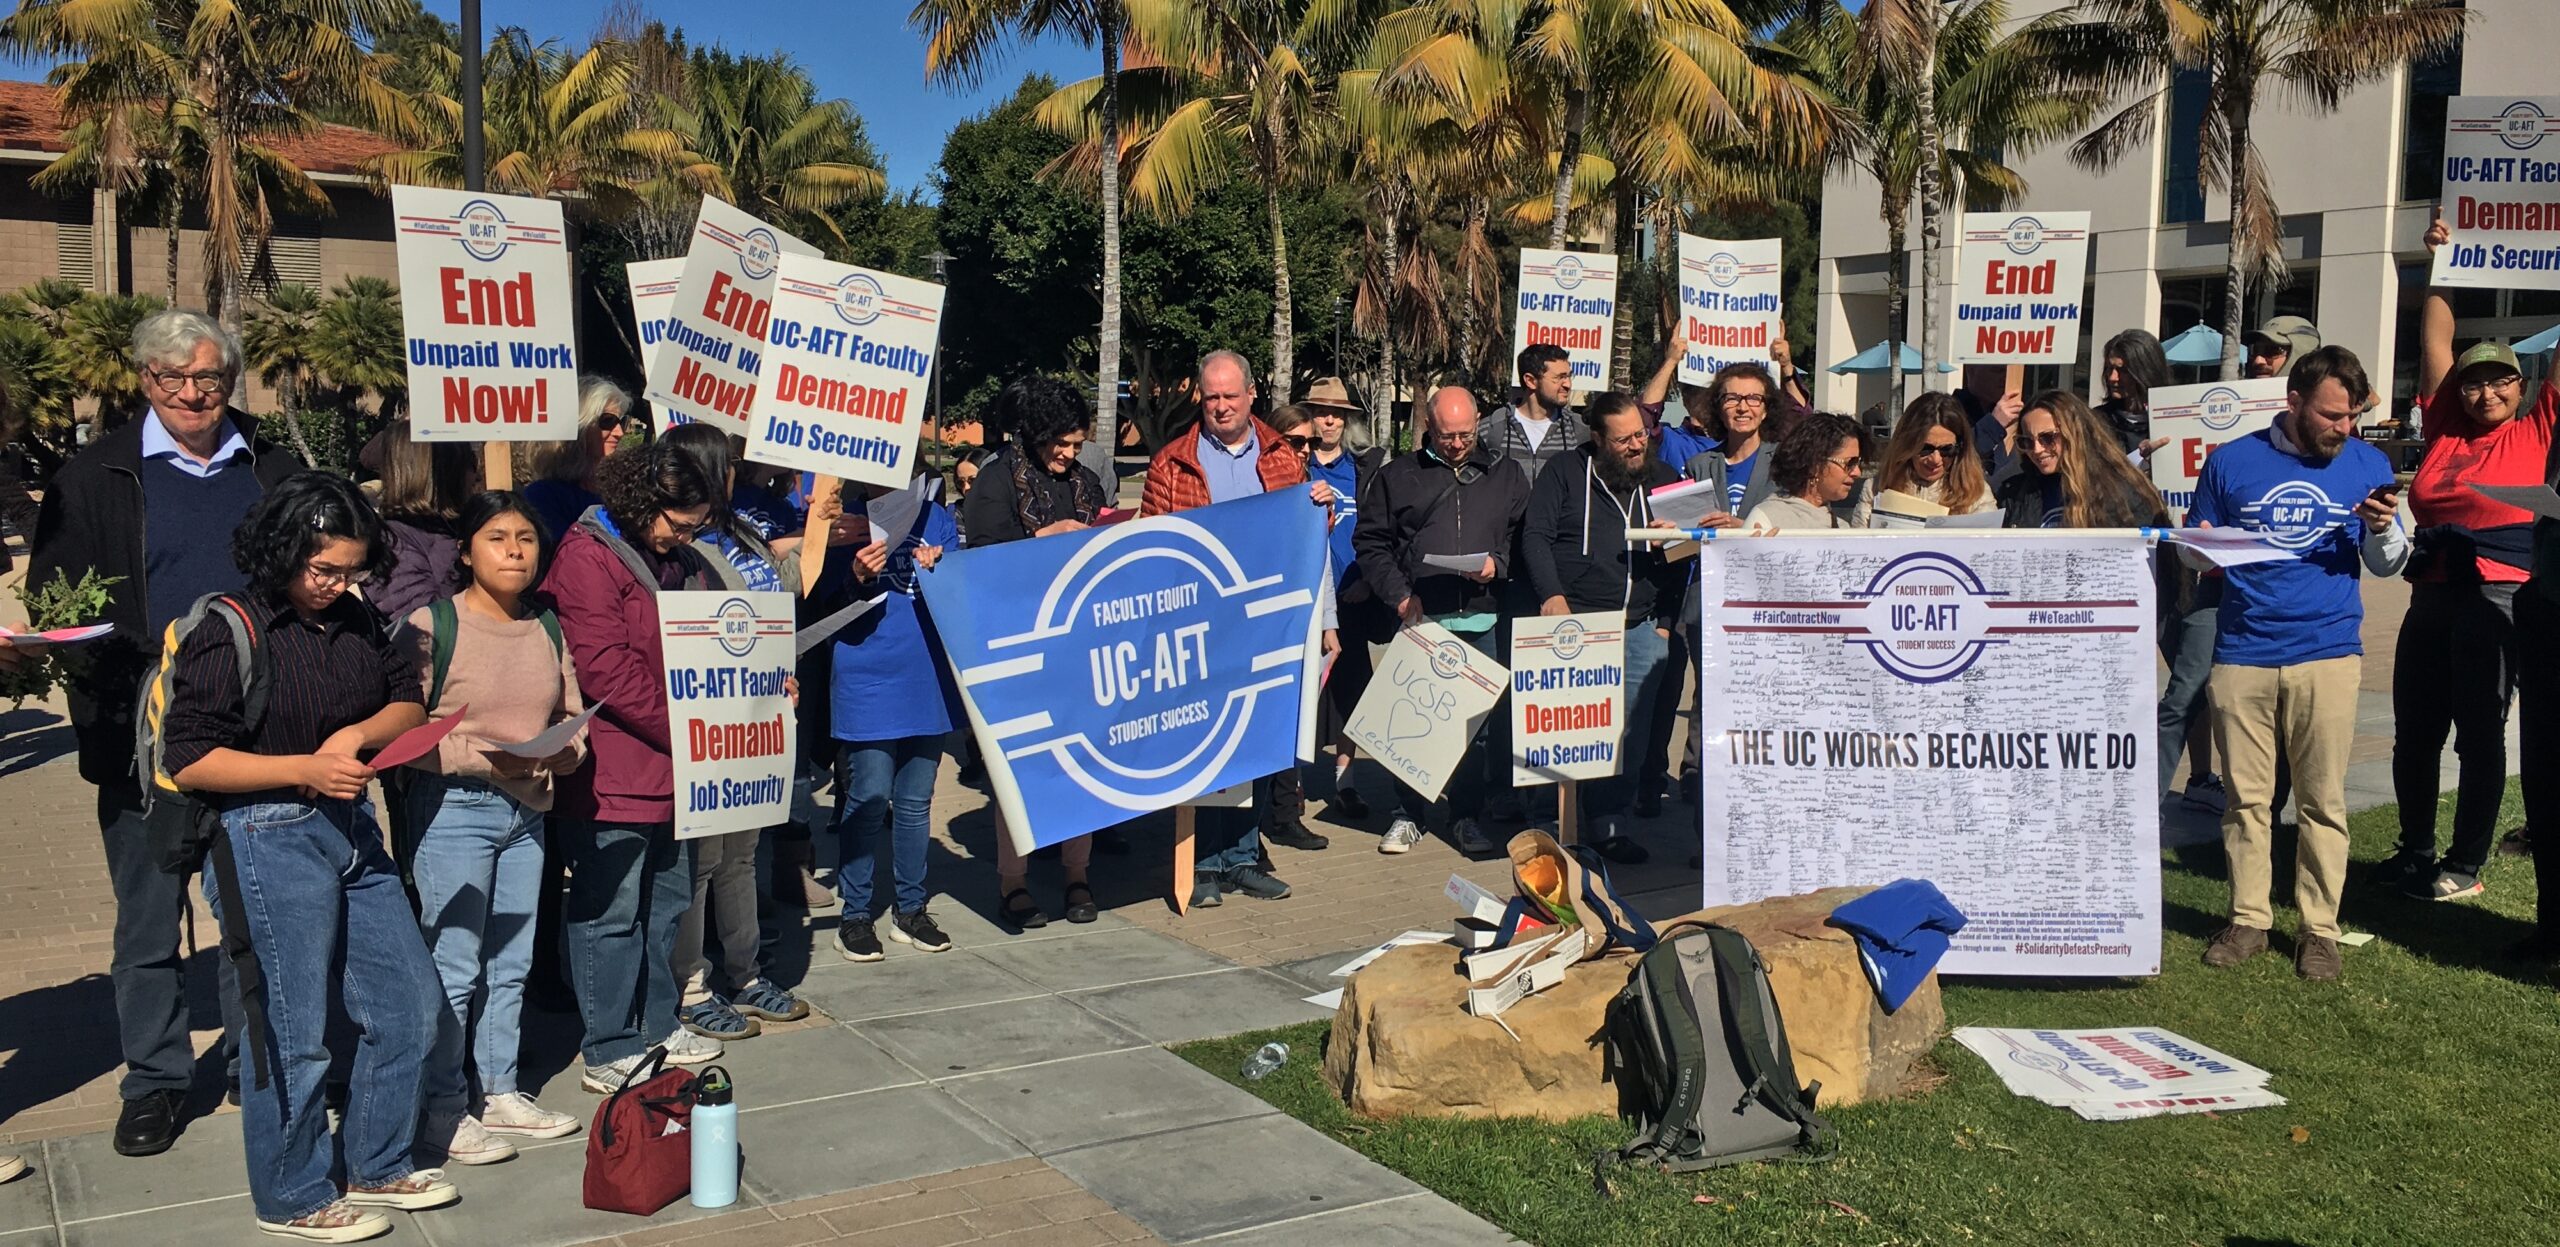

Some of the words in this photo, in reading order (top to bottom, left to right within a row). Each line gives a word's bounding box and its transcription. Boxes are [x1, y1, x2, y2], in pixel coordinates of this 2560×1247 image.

[2509, 121, 2534, 131] UC-AFT
[2447, 157, 2515, 183] UC-AFT
[2458, 196, 2560, 230] Deman
[469, 223, 497, 238] UC-AFT
[2014, 231, 2035, 240] UC-AFT
[748, 244, 770, 264] UC-AFT
[2450, 244, 2486, 268] Job
[2491, 245, 2560, 270] Securi
[1985, 260, 2057, 295] End
[440, 266, 536, 327] End
[703, 270, 773, 342] End
[845, 291, 873, 308] UC-AFT
[1521, 292, 1564, 312] UC-AFT
[1567, 295, 1613, 317] Faculty
[1682, 285, 1720, 311] UC-AFT
[1723, 293, 1778, 312] Faculty
[1958, 304, 2022, 322] Unpaid
[2030, 303, 2079, 320] Work
[667, 316, 733, 363] Unpaid
[1527, 321, 1602, 349] Demand
[1689, 315, 1767, 347] Demand
[1976, 326, 2055, 354] Now!
[409, 338, 500, 369] Unpaid
[509, 341, 573, 369] Work
[770, 318, 848, 358] UC-AFT
[849, 334, 930, 378] Faculty
[1686, 351, 1704, 373] Job
[443, 376, 548, 424] Now!
[672, 355, 757, 422] Now!
[776, 363, 908, 424] Demand
[2208, 404, 2232, 414] UC-AFT
[765, 416, 804, 448] Job
[808, 424, 901, 469] Security
[2273, 507, 2315, 523] UC-AFT
[1093, 593, 1153, 627] FACULTY
[1156, 581, 1199, 614] EQUITY
[1896, 585, 1926, 597] FACULTY
[1928, 585, 1955, 597] EQUITY
[726, 621, 748, 633] UC-AFT
[1752, 610, 1841, 625] #FairContractNow
[1891, 604, 1960, 631] UC-AFT
[2028, 611, 2095, 625] #WeTeachUC
[1559, 634, 1578, 645] UC-AFT
[1896, 640, 1925, 650] STUDENT
[1927, 640, 1956, 650] SUCCESS
[1090, 621, 1210, 706] UC-AFT
[670, 668, 736, 700] UC-AFT
[740, 666, 793, 698] Faculty
[1393, 660, 1456, 721] UCSB
[1514, 667, 1565, 692] UC-AFT
[1569, 664, 1621, 688] Faculty
[1109, 714, 1159, 746] STUDENT
[1161, 700, 1209, 731] SUCCESS
[1525, 698, 1612, 734] Demand
[688, 713, 785, 762] Demand
[1354, 716, 1431, 786] Lecturers
[1726, 729, 1775, 766] THE
[1783, 730, 1816, 767] UC
[1824, 731, 1919, 768] WORKS
[1927, 733, 2049, 769] BECAUSE
[2057, 733, 2098, 769] WE
[2106, 733, 2136, 769] DO
[1525, 746, 1549, 769] Job
[1553, 740, 1613, 765] Security
[689, 780, 718, 812] Job
[722, 773, 785, 809] Security
[2015, 942, 2132, 957] #SolidarityDefeatsPrecarity
[2031, 1030, 2097, 1061] Faculty
[2076, 1035, 2194, 1080] Demand
[2128, 1031, 2207, 1061] Security
[2078, 1062, 2149, 1090] UC-AFT
[2195, 1060, 2239, 1073] Job
